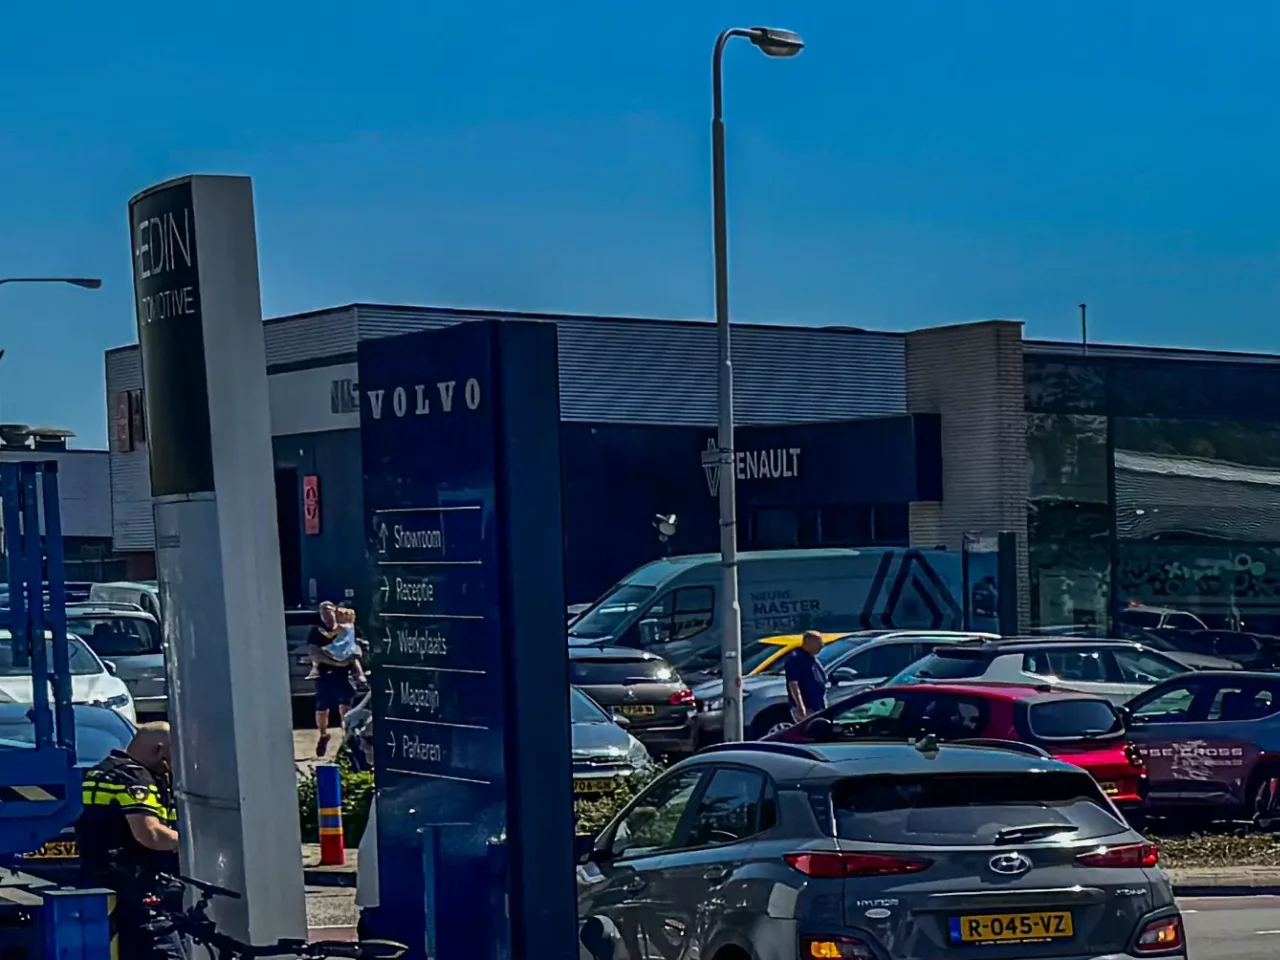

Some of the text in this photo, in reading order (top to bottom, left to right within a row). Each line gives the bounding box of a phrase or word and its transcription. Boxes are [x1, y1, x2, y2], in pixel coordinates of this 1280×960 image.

[137, 207, 192, 280] EDIN
[366, 377, 482, 420] VOLVO
[736, 448, 801, 480] ENAULT
[394, 524, 442, 549] Showroom
[753, 600, 820, 615] MASTER
[968, 914, 1066, 937] R-045-VZ
